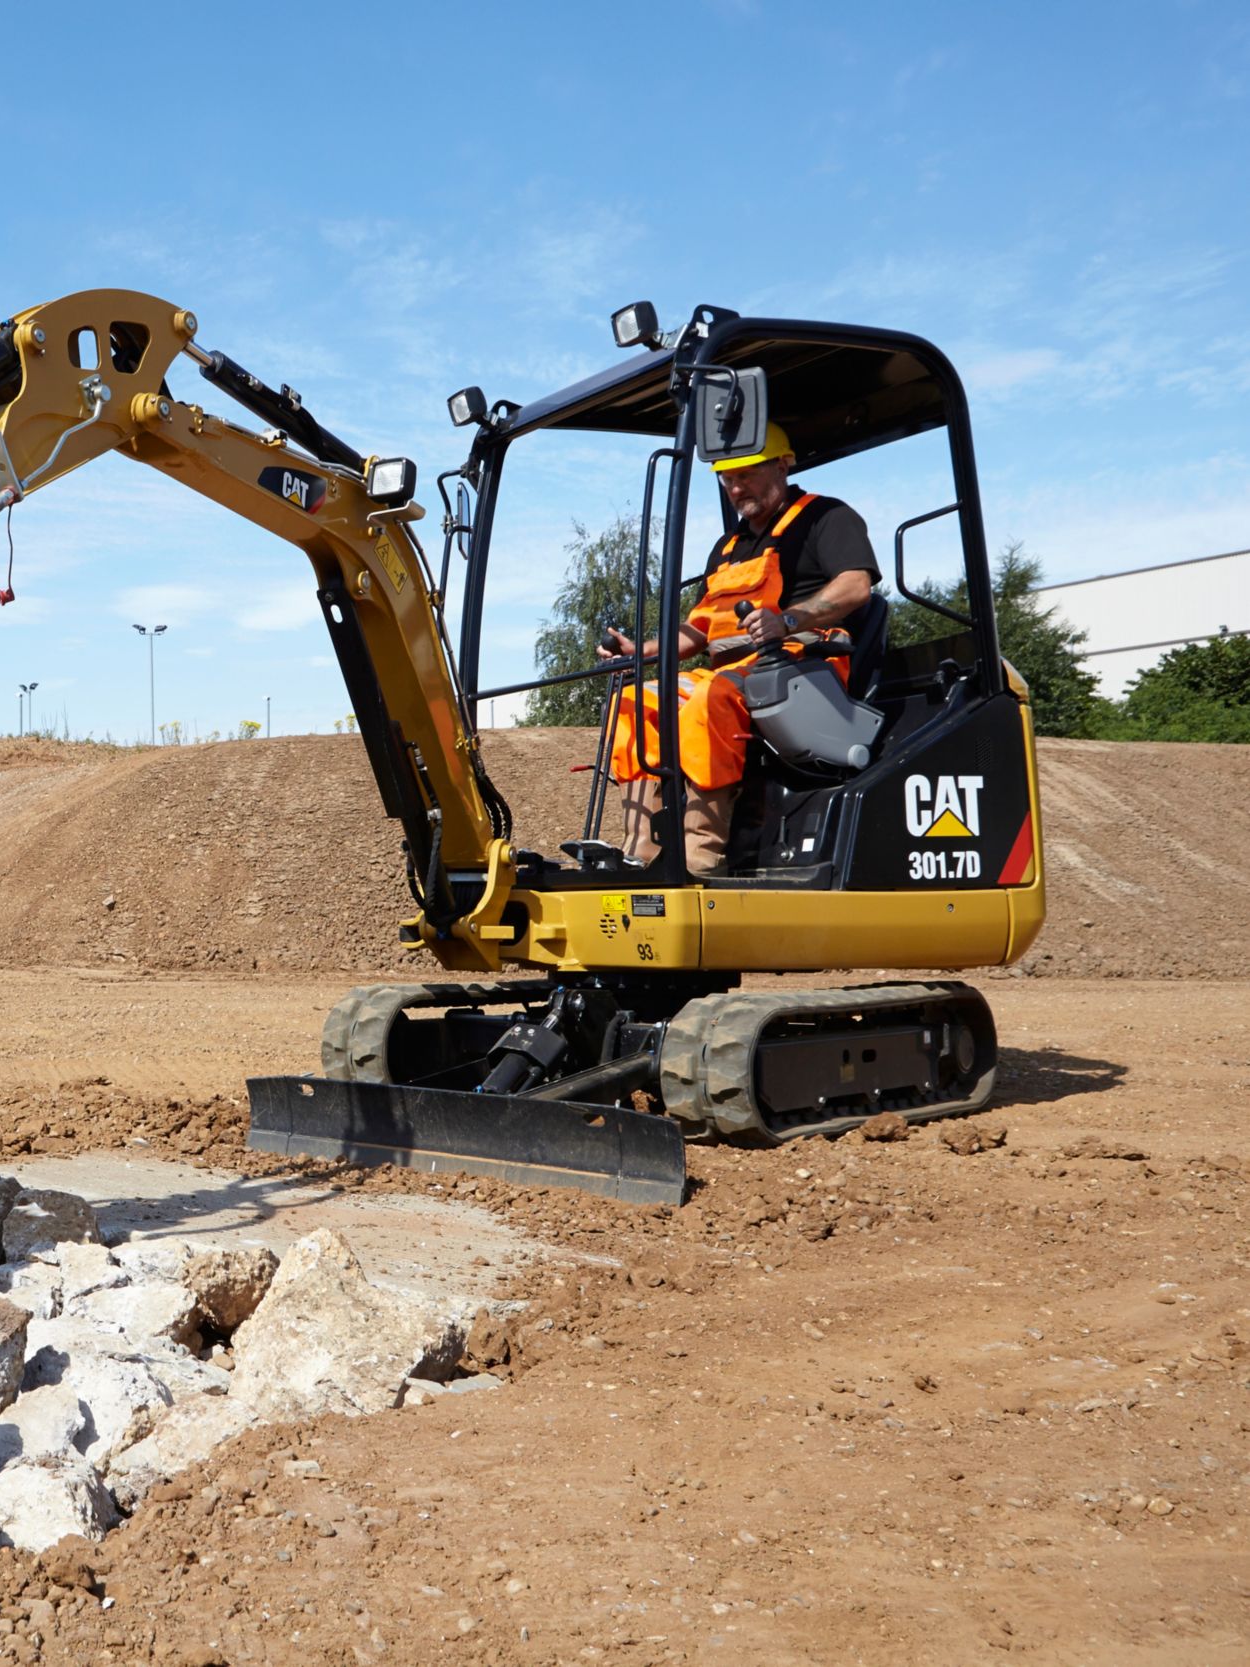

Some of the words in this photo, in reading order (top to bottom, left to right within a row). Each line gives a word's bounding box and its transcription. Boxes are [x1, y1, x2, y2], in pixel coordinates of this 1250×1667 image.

[282, 471, 309, 509] CAT
[904, 774, 984, 837] CAT
[908, 850, 981, 880] 301.7D
[637, 943, 654, 960] 93
